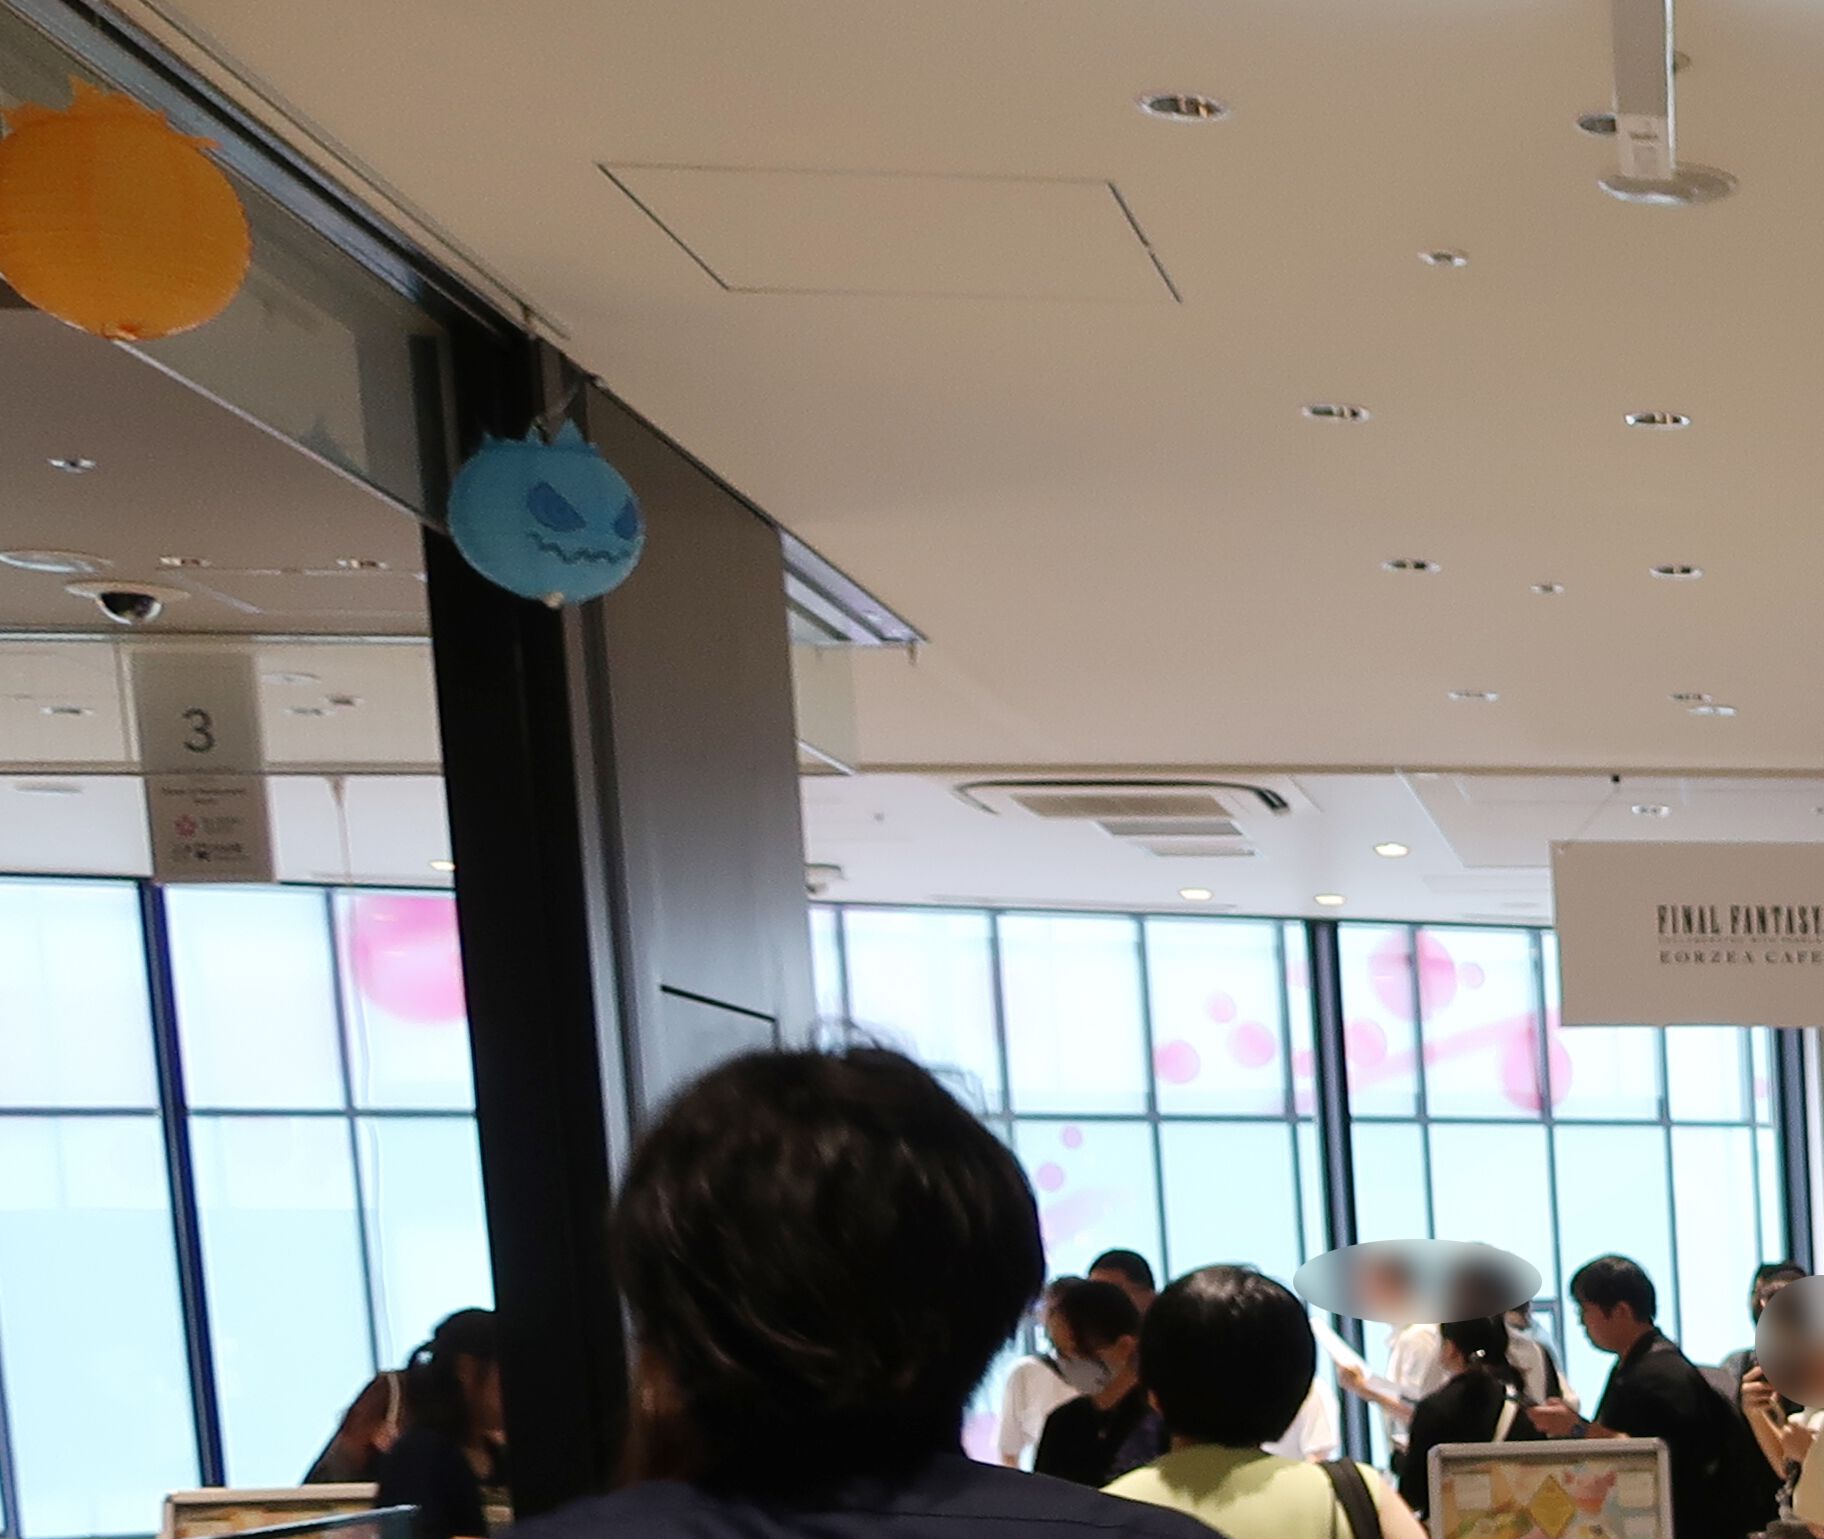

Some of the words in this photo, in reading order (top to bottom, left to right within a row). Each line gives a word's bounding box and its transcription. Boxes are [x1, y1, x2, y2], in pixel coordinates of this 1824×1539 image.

[181, 707, 215, 753] 3
[1657, 904, 1720, 934] FINAL
[1730, 904, 1823, 934] FANTASY
[1659, 950, 1755, 964] EORZEA
[1764, 950, 1823, 964] CAFE
